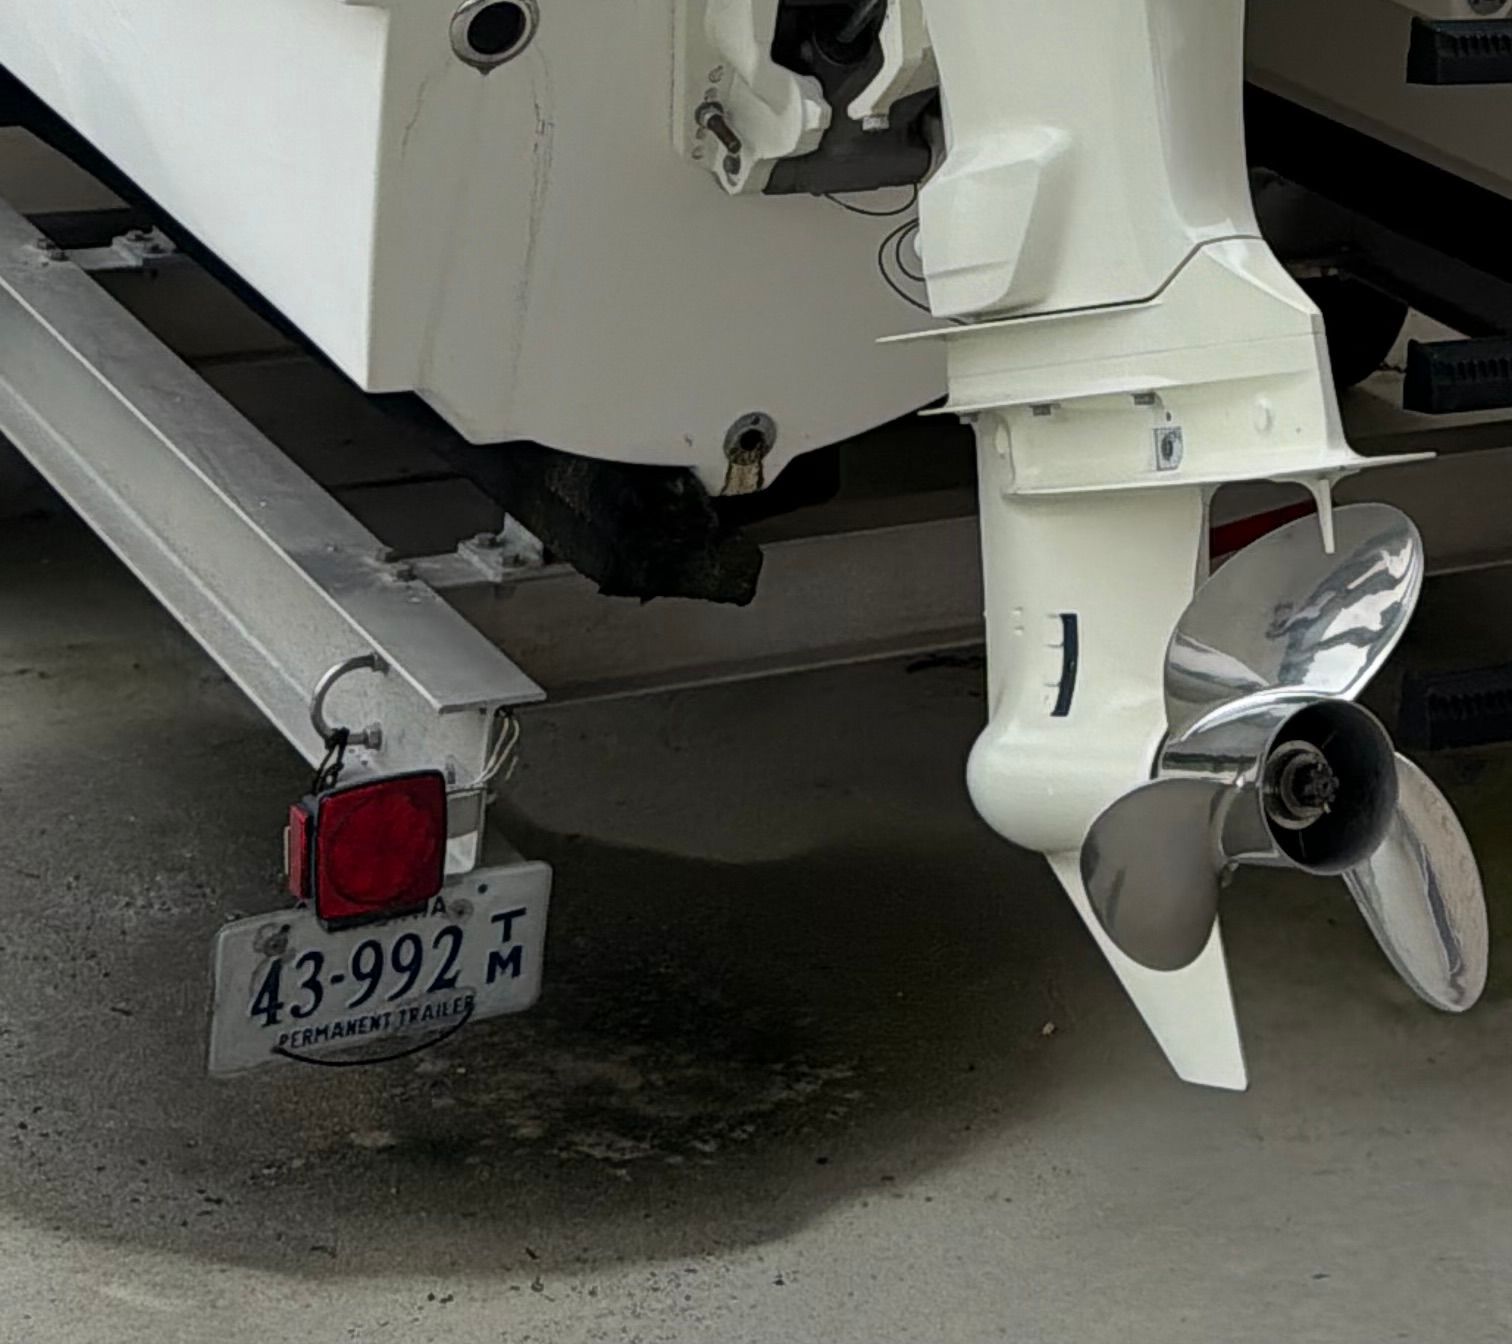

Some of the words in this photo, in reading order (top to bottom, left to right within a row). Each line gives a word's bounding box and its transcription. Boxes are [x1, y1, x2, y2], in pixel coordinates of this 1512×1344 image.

[250, 925, 463, 1028] 43-992
[277, 1012, 391, 1048] PERMANENT
[397, 993, 476, 1027] TRAILER
